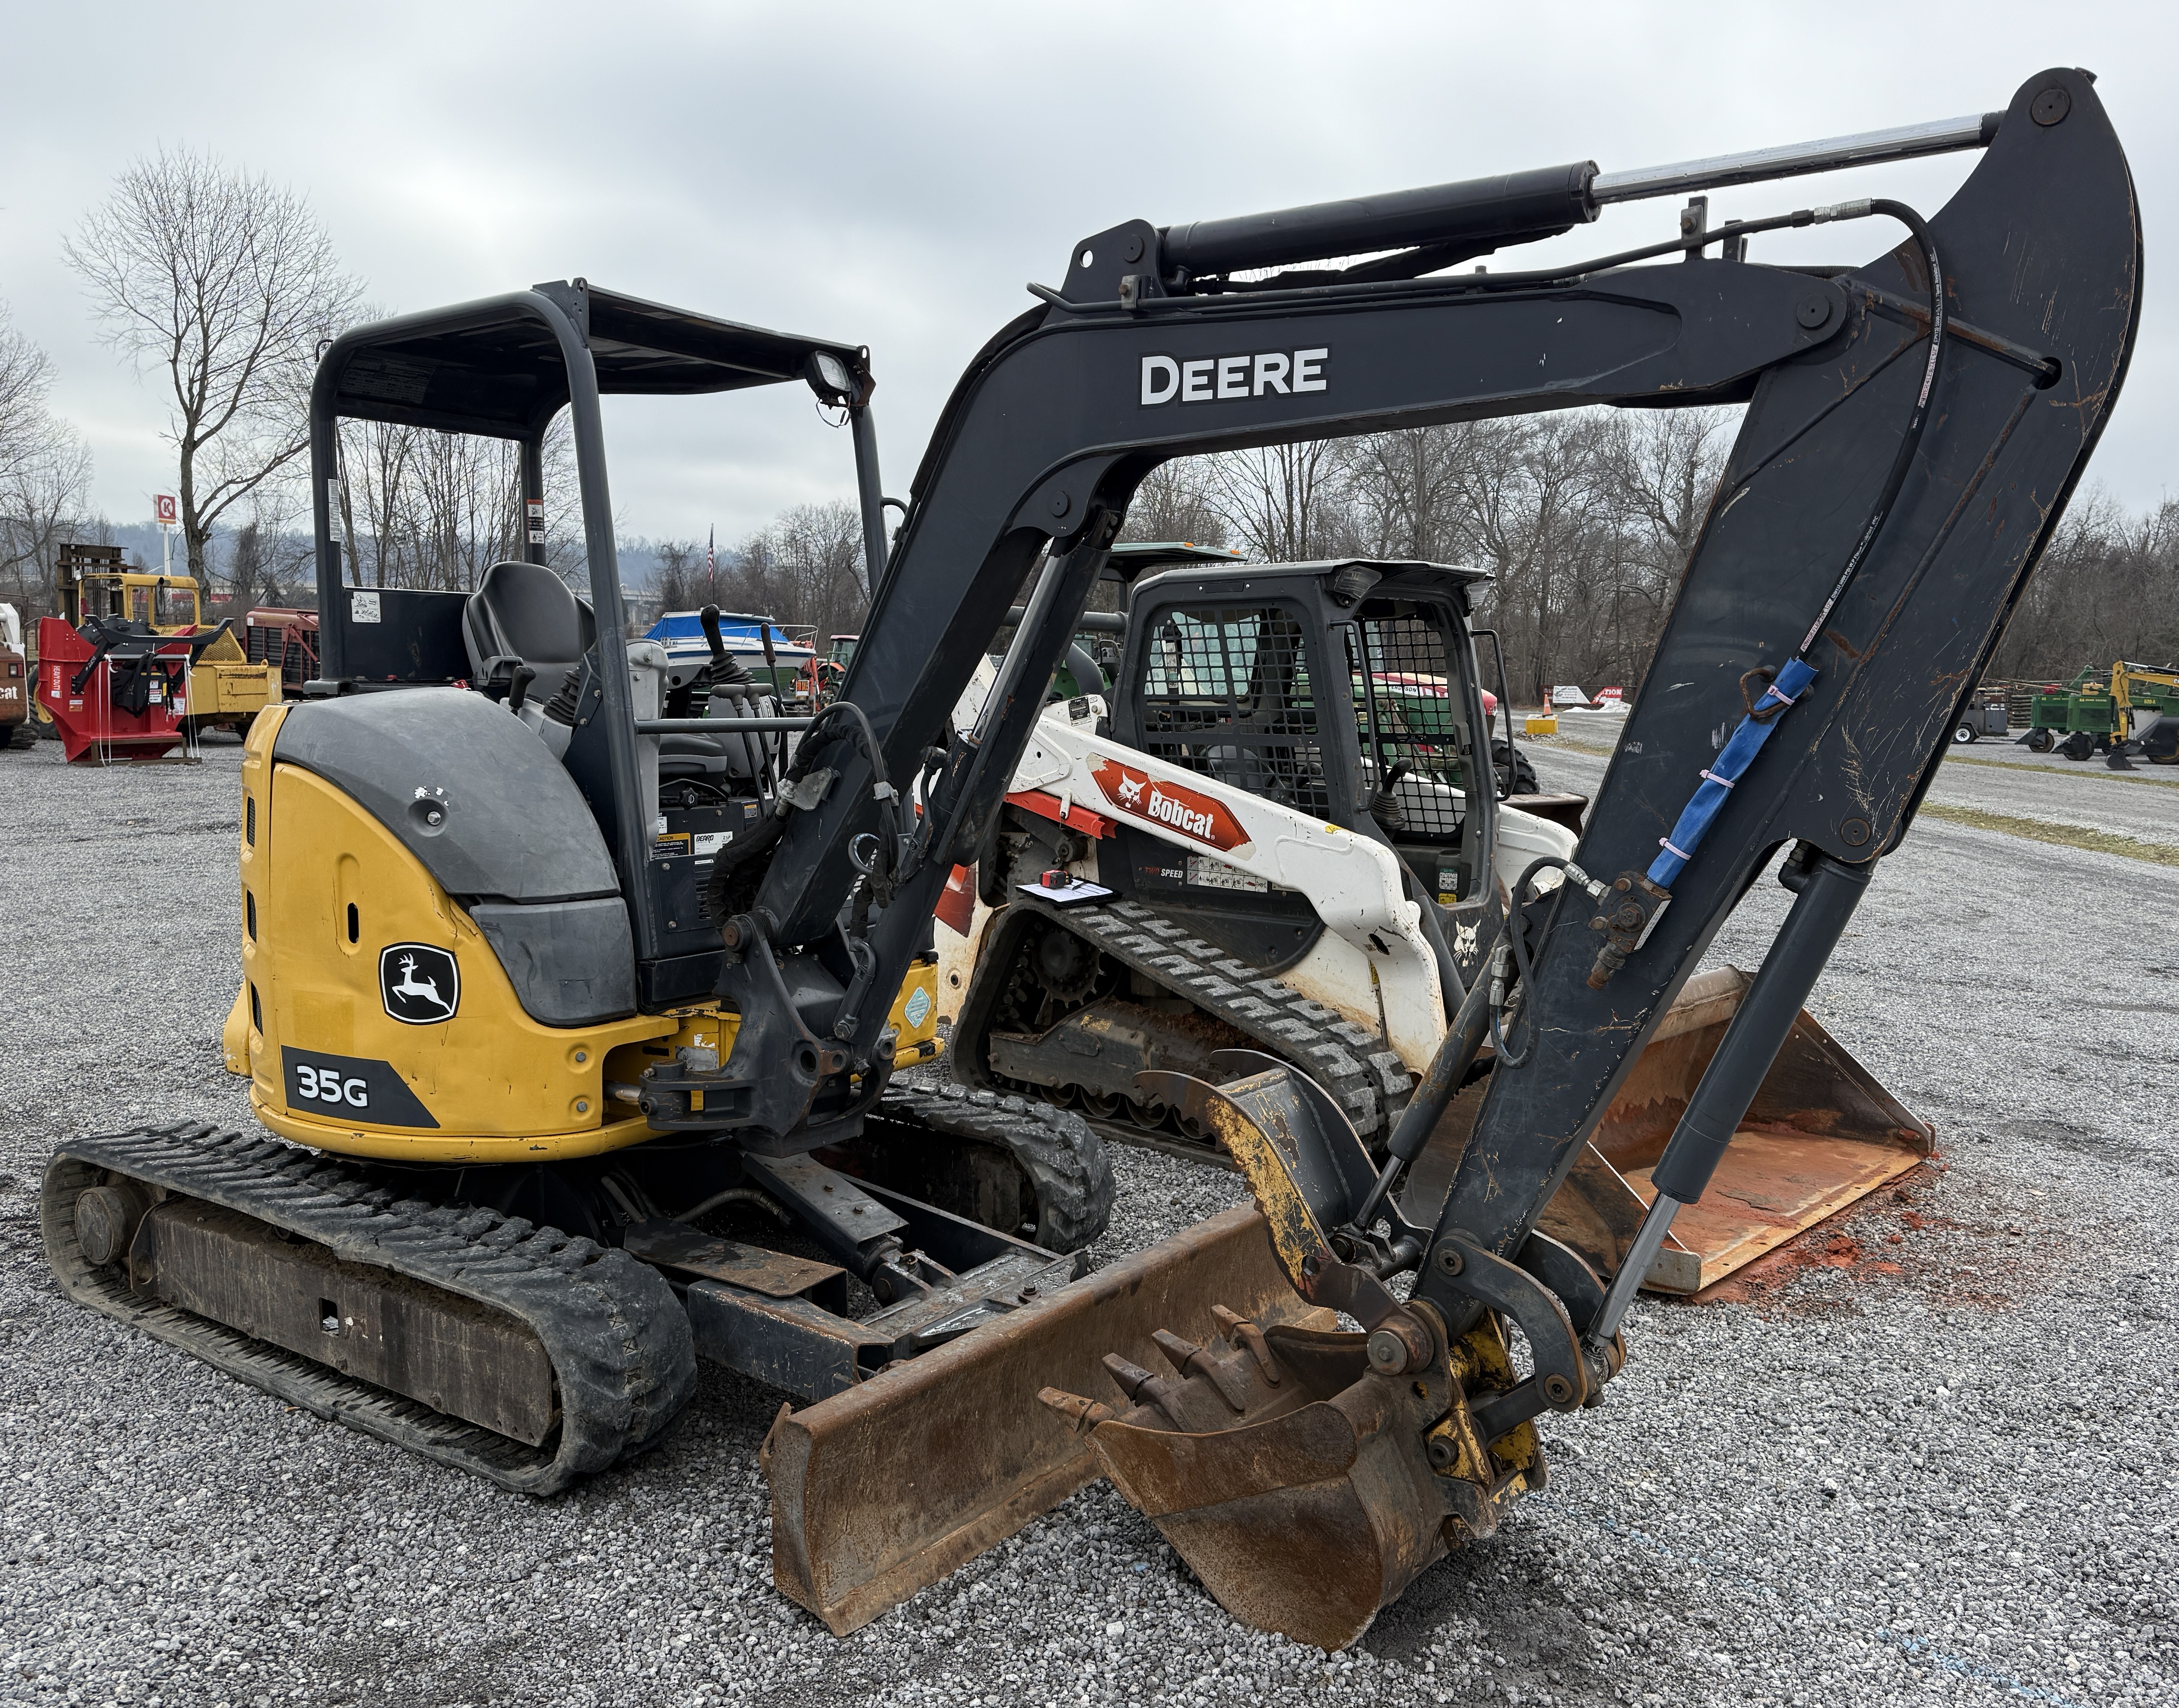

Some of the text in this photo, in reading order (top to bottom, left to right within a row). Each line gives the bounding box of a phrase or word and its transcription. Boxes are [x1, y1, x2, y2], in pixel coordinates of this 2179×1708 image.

[1141, 348, 1328, 405] DEERE
[1148, 790, 1214, 839] Bobcat
[1144, 867, 1183, 878] TWO SPEED
[297, 1065, 368, 1107] 35G
